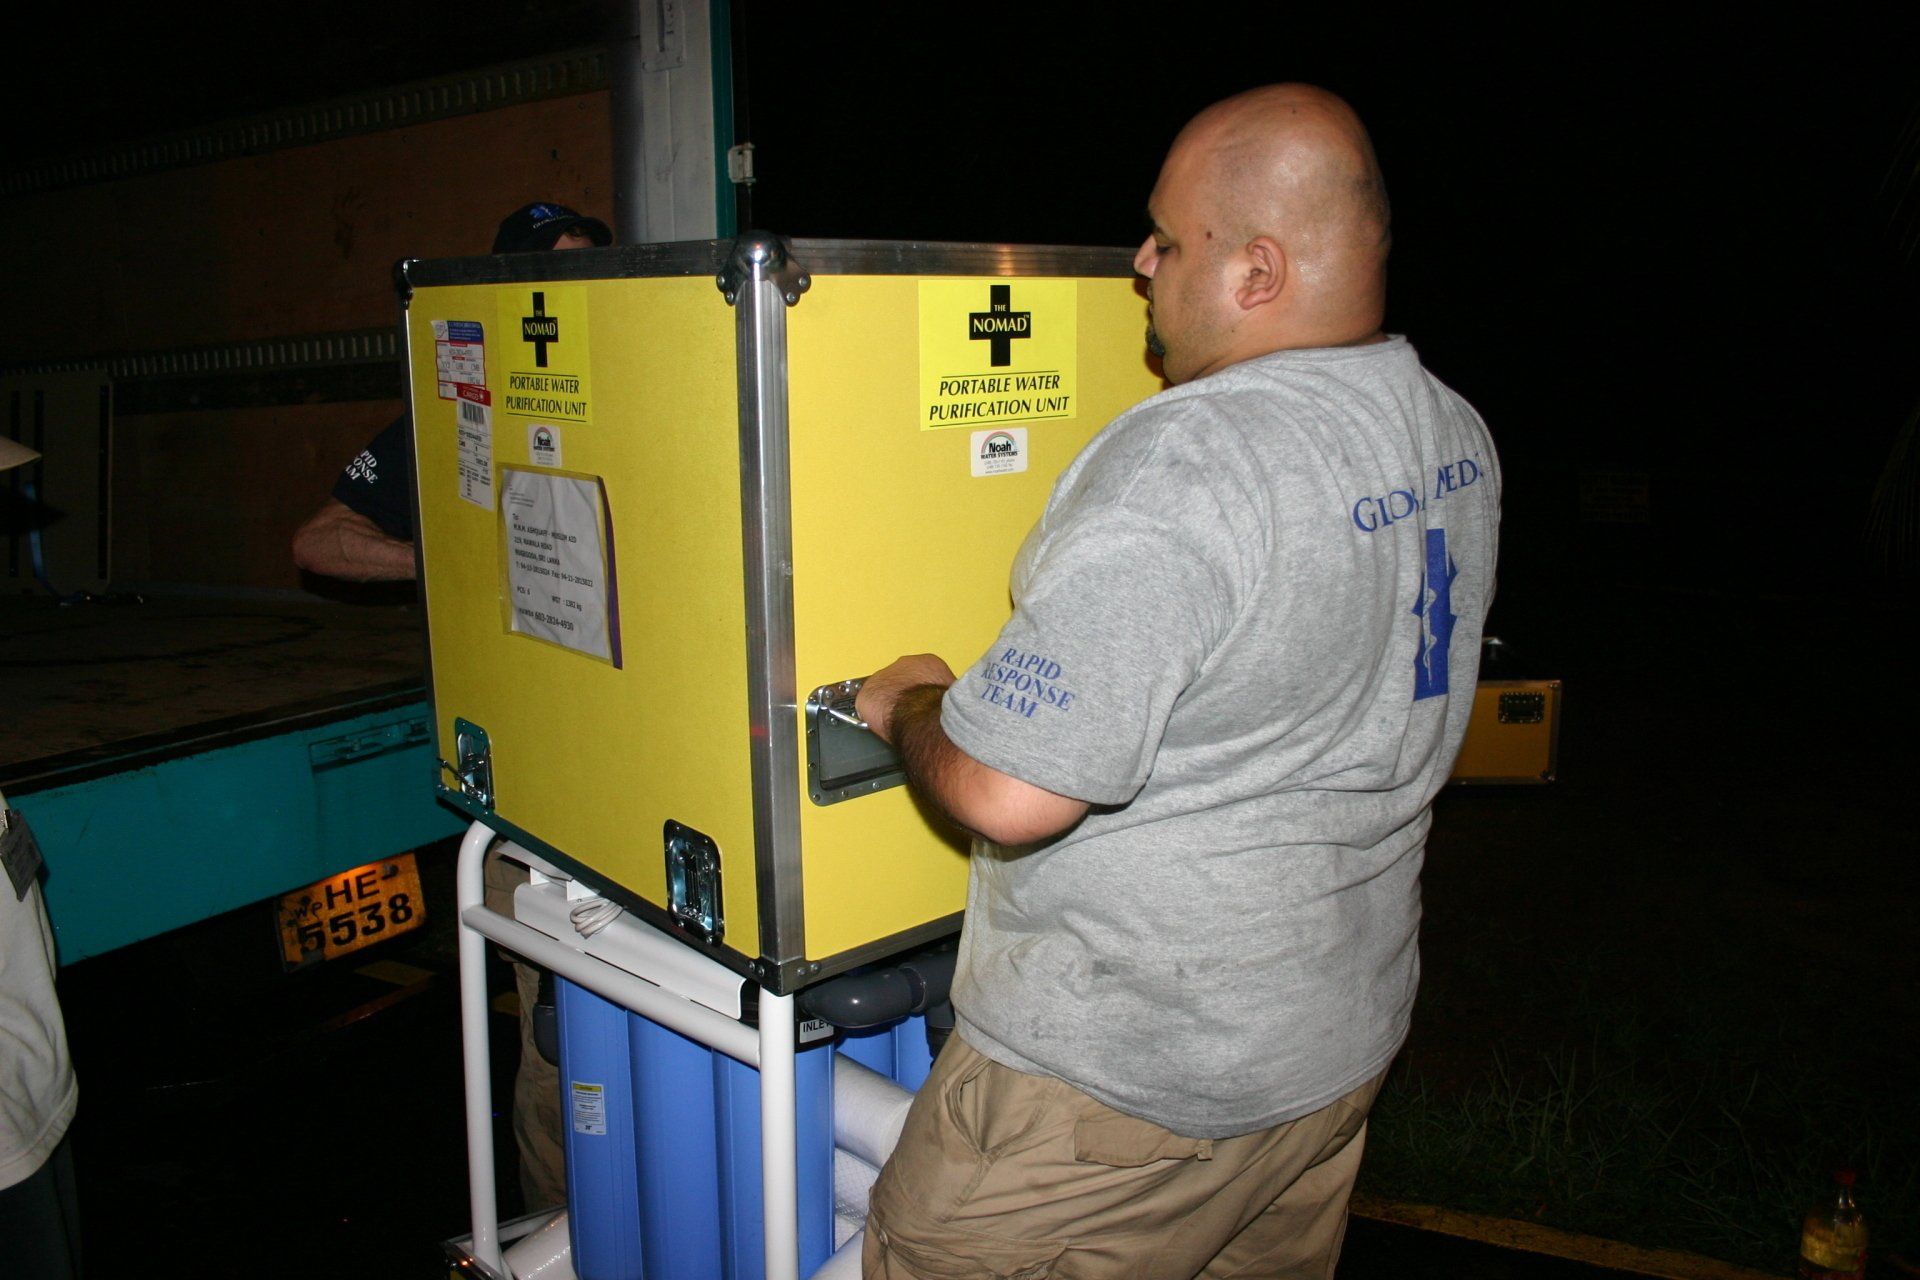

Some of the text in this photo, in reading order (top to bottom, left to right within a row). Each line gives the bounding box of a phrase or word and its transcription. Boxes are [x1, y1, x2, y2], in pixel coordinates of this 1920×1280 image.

[524, 322, 556, 335] NOMAD
[973, 317, 1027, 333] NOMAD
[510, 376, 579, 394] PORTABLE WATER
[939, 375, 1060, 396] PORTABLE WATER
[506, 395, 587, 416] PURIFICATION UNIT
[930, 396, 1070, 421] PURIFICATION UNIT
[989, 440, 1012, 453] Noah
[1000, 647, 1061, 680] RAPID
[981, 683, 1039, 718] TEAM
[297, 893, 413, 953] 5538
